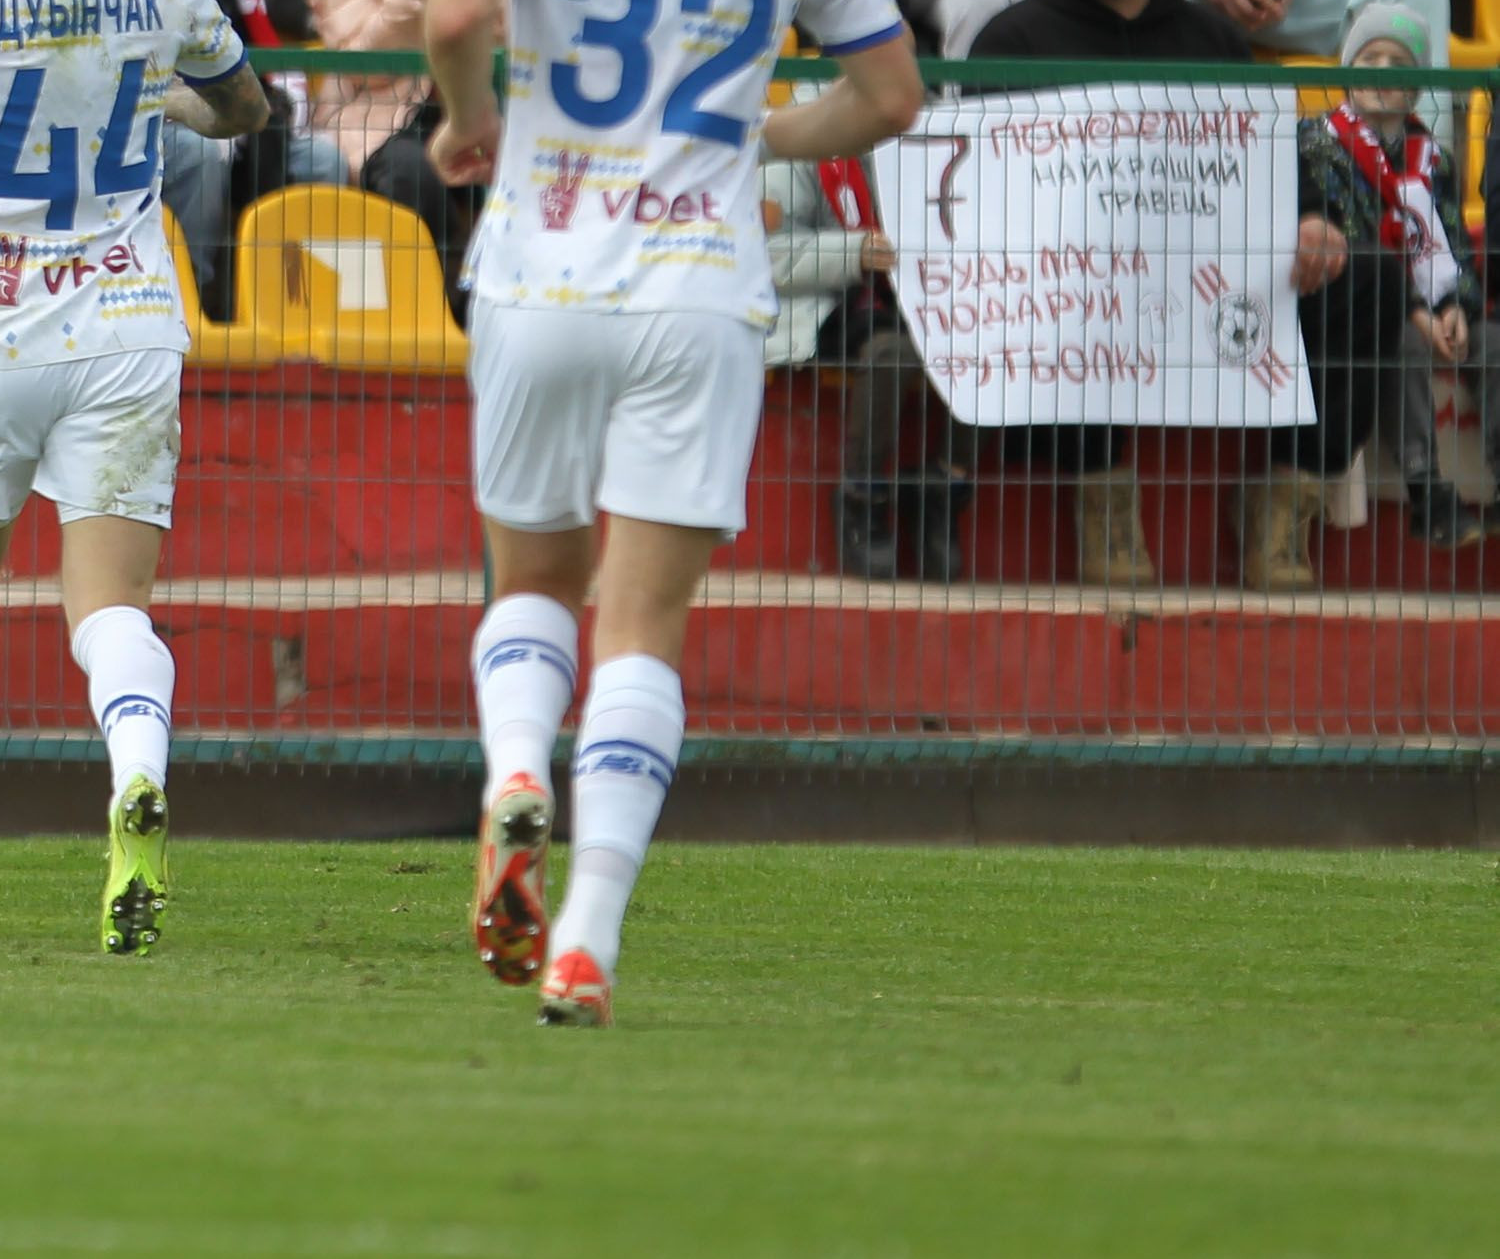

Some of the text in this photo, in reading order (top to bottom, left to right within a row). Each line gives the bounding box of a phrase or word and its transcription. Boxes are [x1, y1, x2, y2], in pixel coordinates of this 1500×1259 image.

[898, 133, 970, 242] 7
[1034, 151, 1242, 188] НАЙКРАЩИЙ
[600, 181, 724, 225] vbet
[1097, 187, 1218, 218] ГРАВЕЦЬ
[915, 244, 1151, 298] БУДЬ ЛАСКА
[913, 284, 1125, 340] ПОДАРУЙ
[932, 342, 1159, 390] ФУТБОЛКУ
